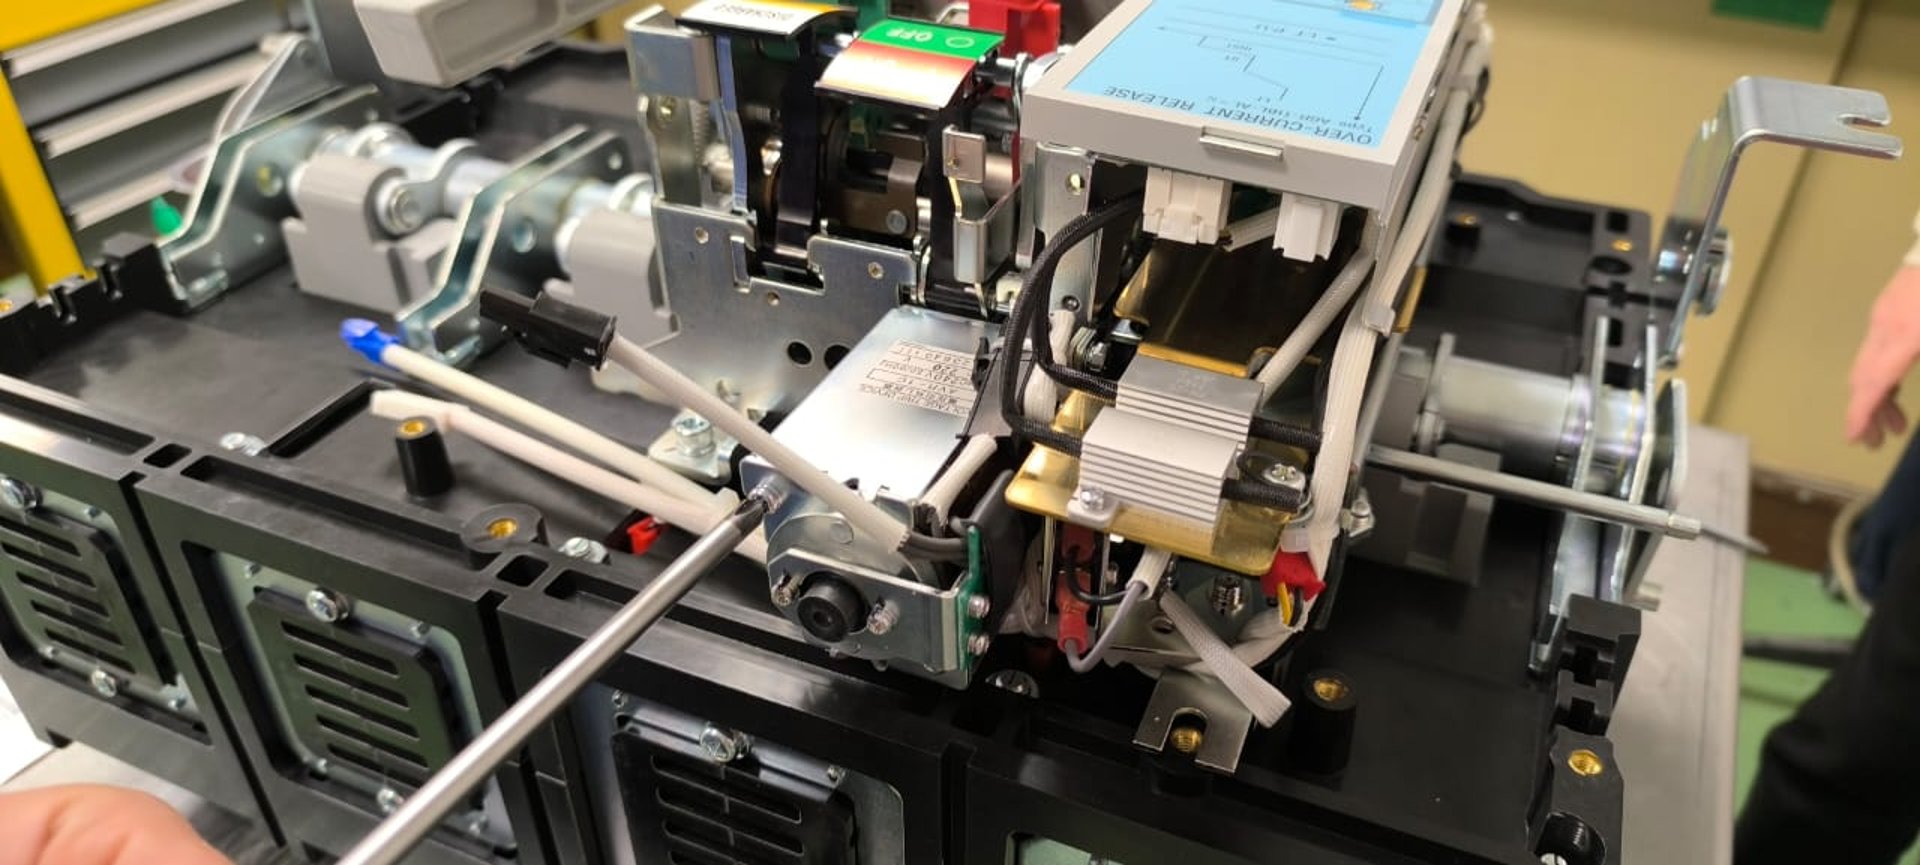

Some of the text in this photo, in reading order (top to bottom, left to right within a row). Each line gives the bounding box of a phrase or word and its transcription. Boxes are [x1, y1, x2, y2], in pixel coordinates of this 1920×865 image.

[885, 28, 933, 43] OFF
[1104, 86, 1373, 145] OVER-CURRENT RELEASE
